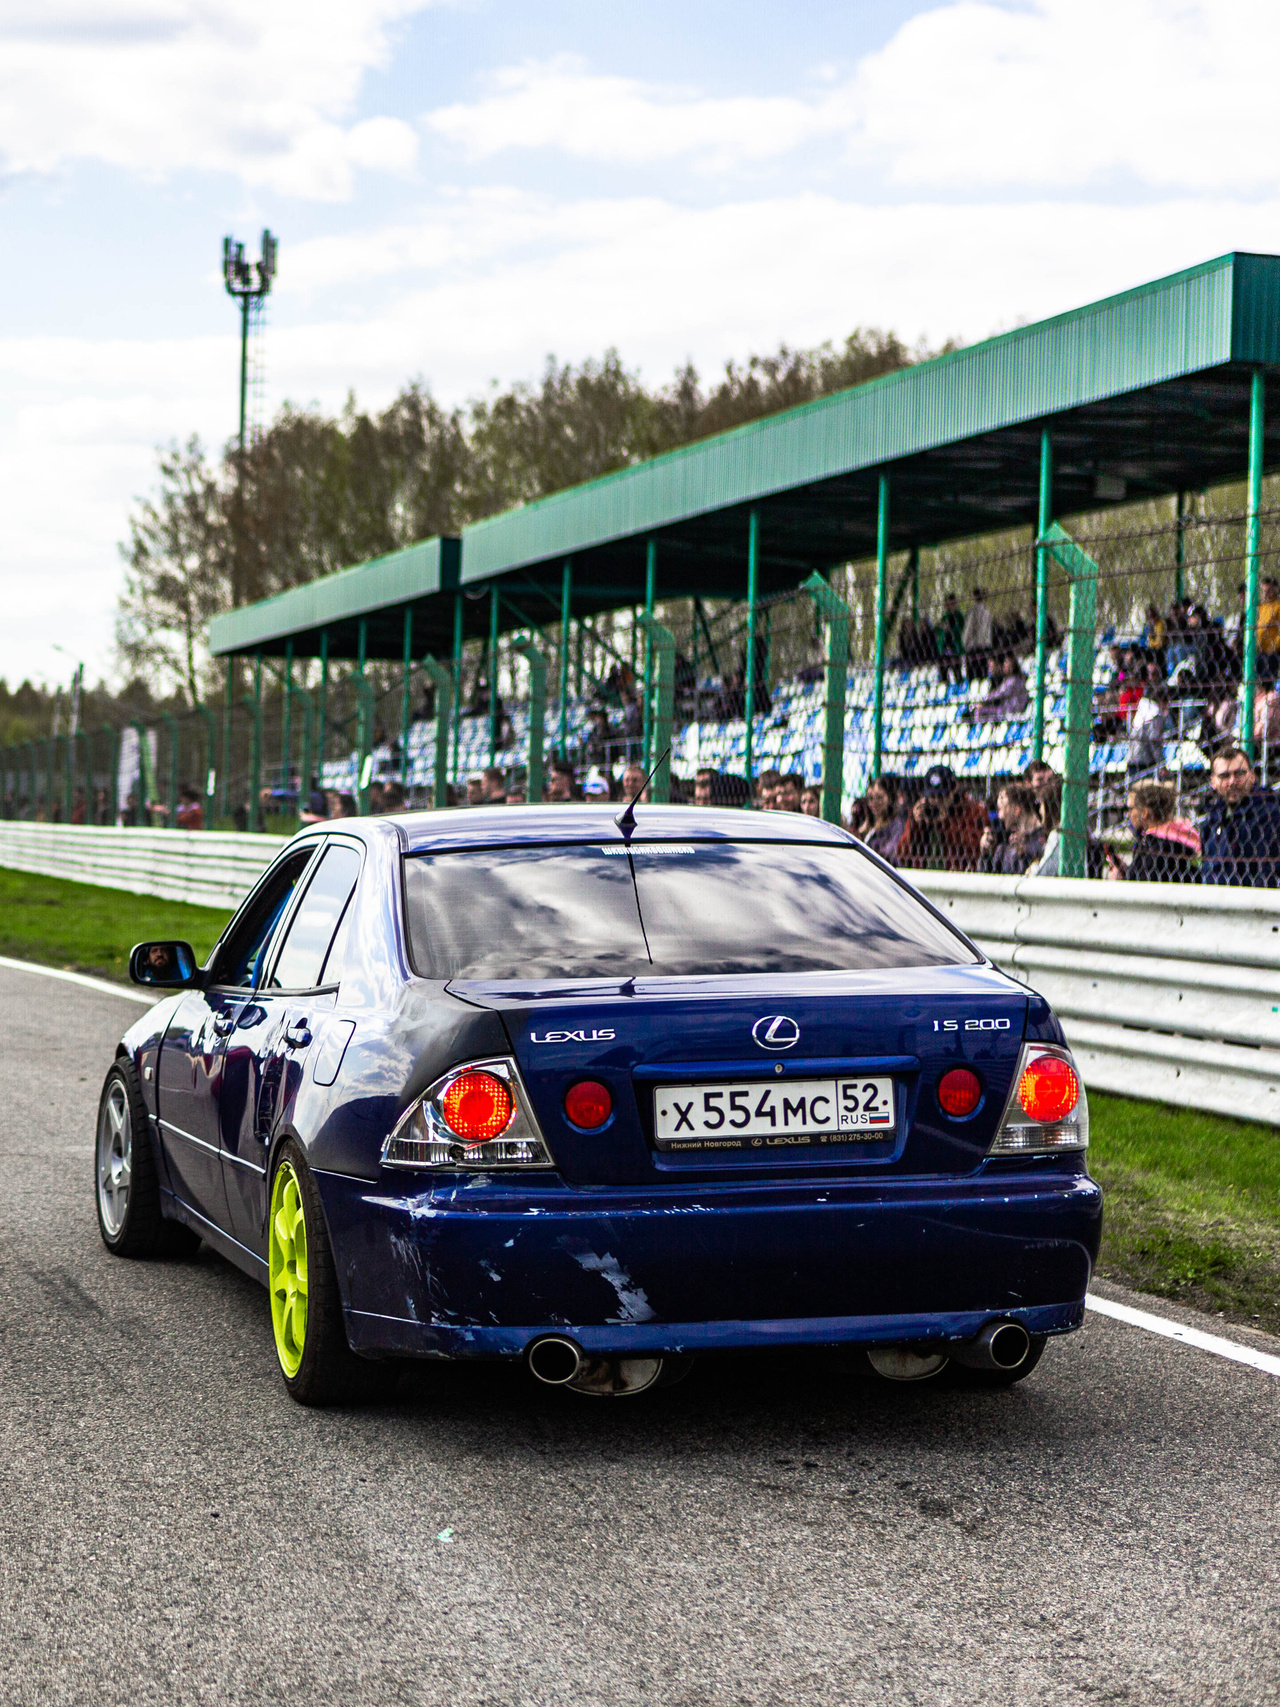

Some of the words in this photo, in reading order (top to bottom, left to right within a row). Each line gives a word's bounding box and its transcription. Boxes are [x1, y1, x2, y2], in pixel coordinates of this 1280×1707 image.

[964, 1018, 1011, 1031] 200
[530, 1028, 616, 1043] LEXUS
[842, 1083, 879, 1113] 52
[841, 1113, 868, 1125] RUS
[671, 1141, 702, 1149] Нижний
[704, 1140, 741, 1148] Новгород
[766, 1136, 811, 1145] LEXUS
[829, 1134, 847, 1143] (831)
[848, 1132, 884, 1141] 275-30-00
